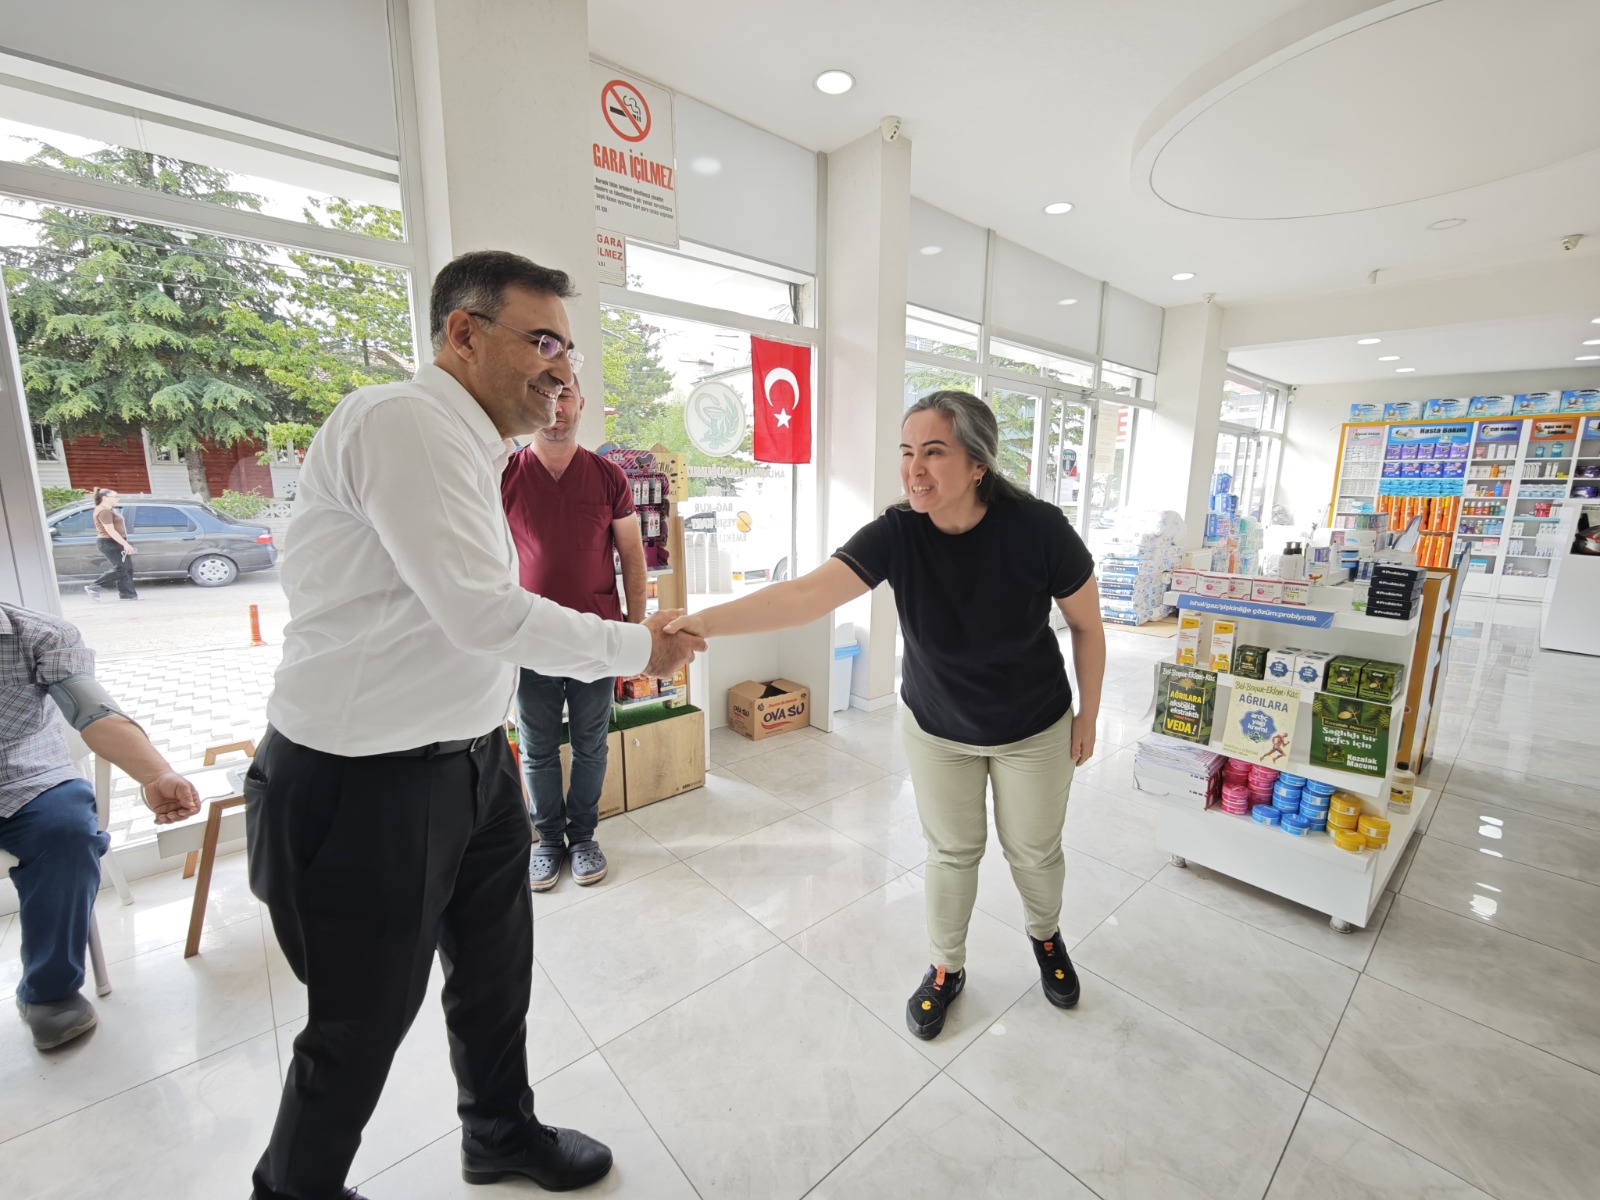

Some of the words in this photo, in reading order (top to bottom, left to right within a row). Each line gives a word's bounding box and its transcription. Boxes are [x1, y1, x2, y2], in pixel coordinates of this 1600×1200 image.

[629, 148, 674, 191] İÇİLMEZ
[597, 234, 622, 248] GARA
[1170, 690, 1202, 704] AĞRILARA
[1239, 693, 1288, 713] AĞRILARA
[764, 708, 786, 722] OVA
[788, 702, 805, 717] SU
[1251, 713, 1268, 722] ardıç
[1248, 724, 1268, 734] kremi
[1325, 736, 1350, 745] nefes
[1347, 754, 1377, 764] Kozalak
[1346, 760, 1378, 771] Macunu
